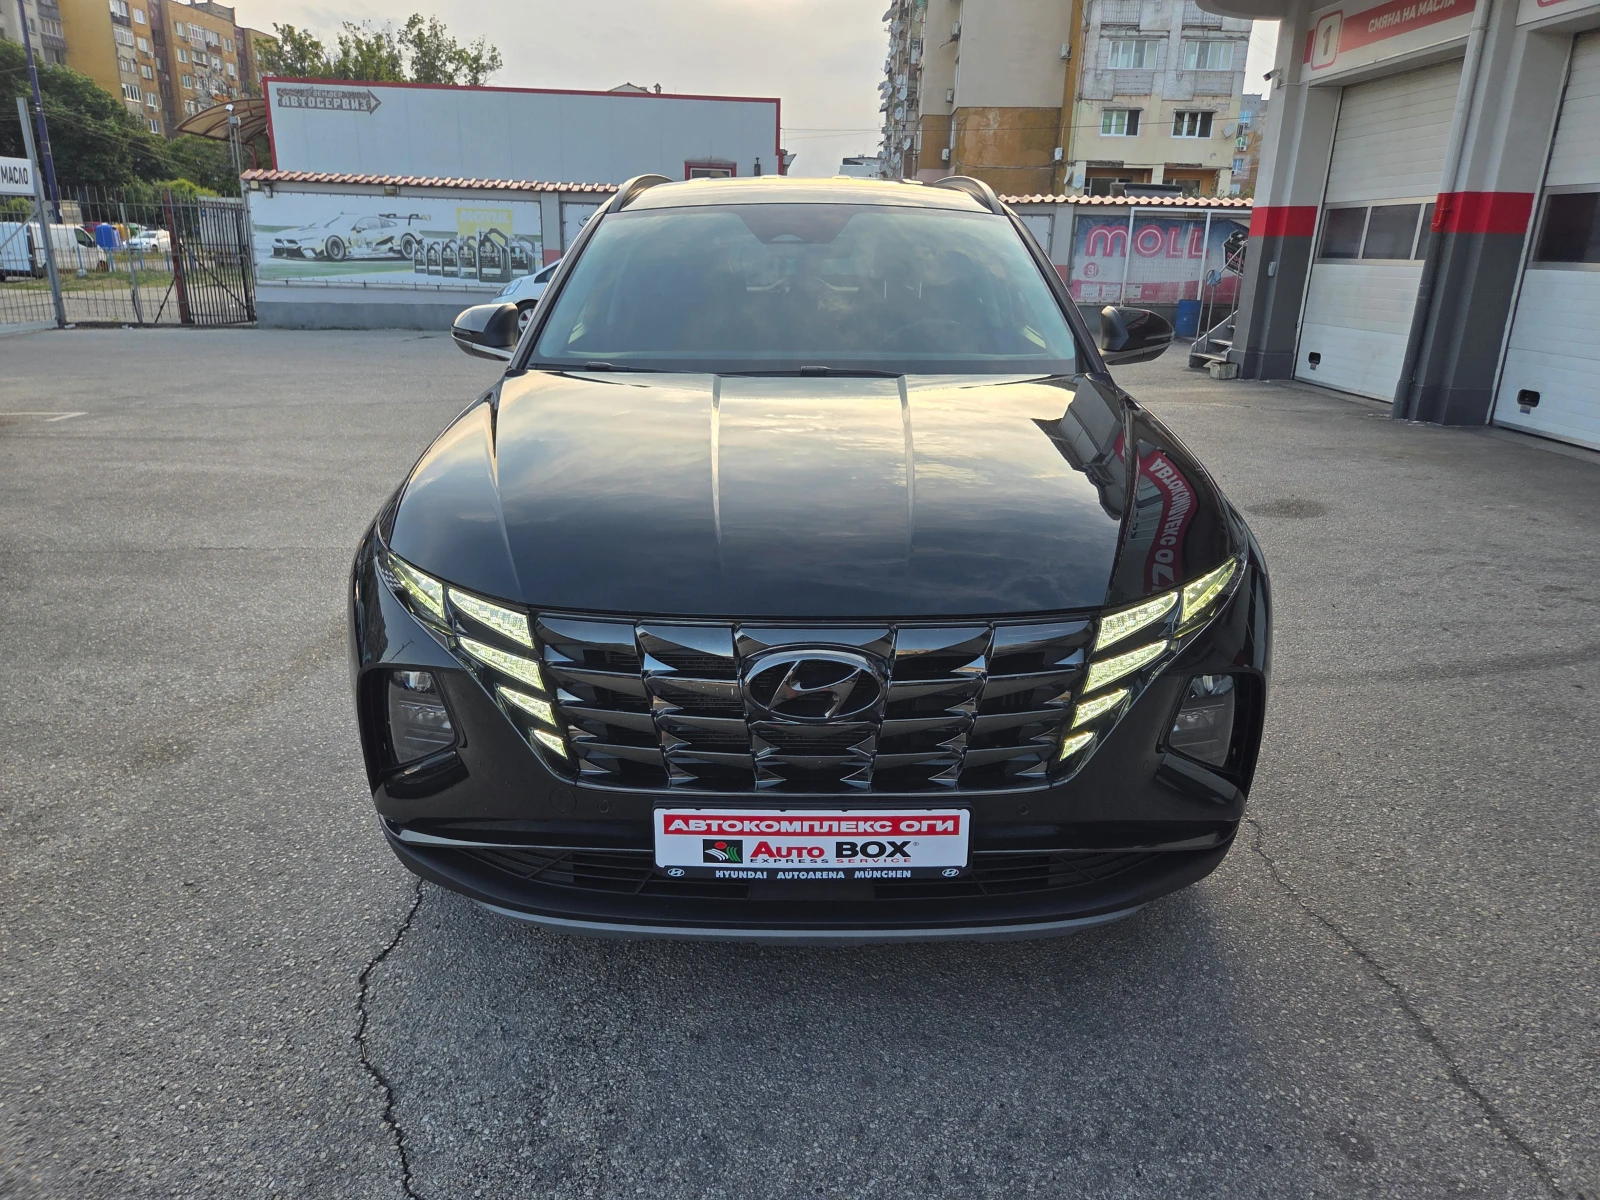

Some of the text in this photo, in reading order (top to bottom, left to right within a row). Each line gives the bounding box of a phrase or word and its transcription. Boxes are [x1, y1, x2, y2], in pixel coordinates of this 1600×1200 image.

[1367, 10, 1400, 33] СМЯНА
[1401, 4, 1416, 22] НА
[1322, 25, 1333, 56] 1
[281, 95, 368, 110] АВТОСЕРВИЗ
[0, 165, 29, 185] МАСЛО
[460, 209, 510, 224] MOTUL
[668, 819, 955, 833] АВТОКОМПЛЕКС ОГИ
[715, 869, 912, 879] HYUNDAI AUTOARENA MÜNCHEN
